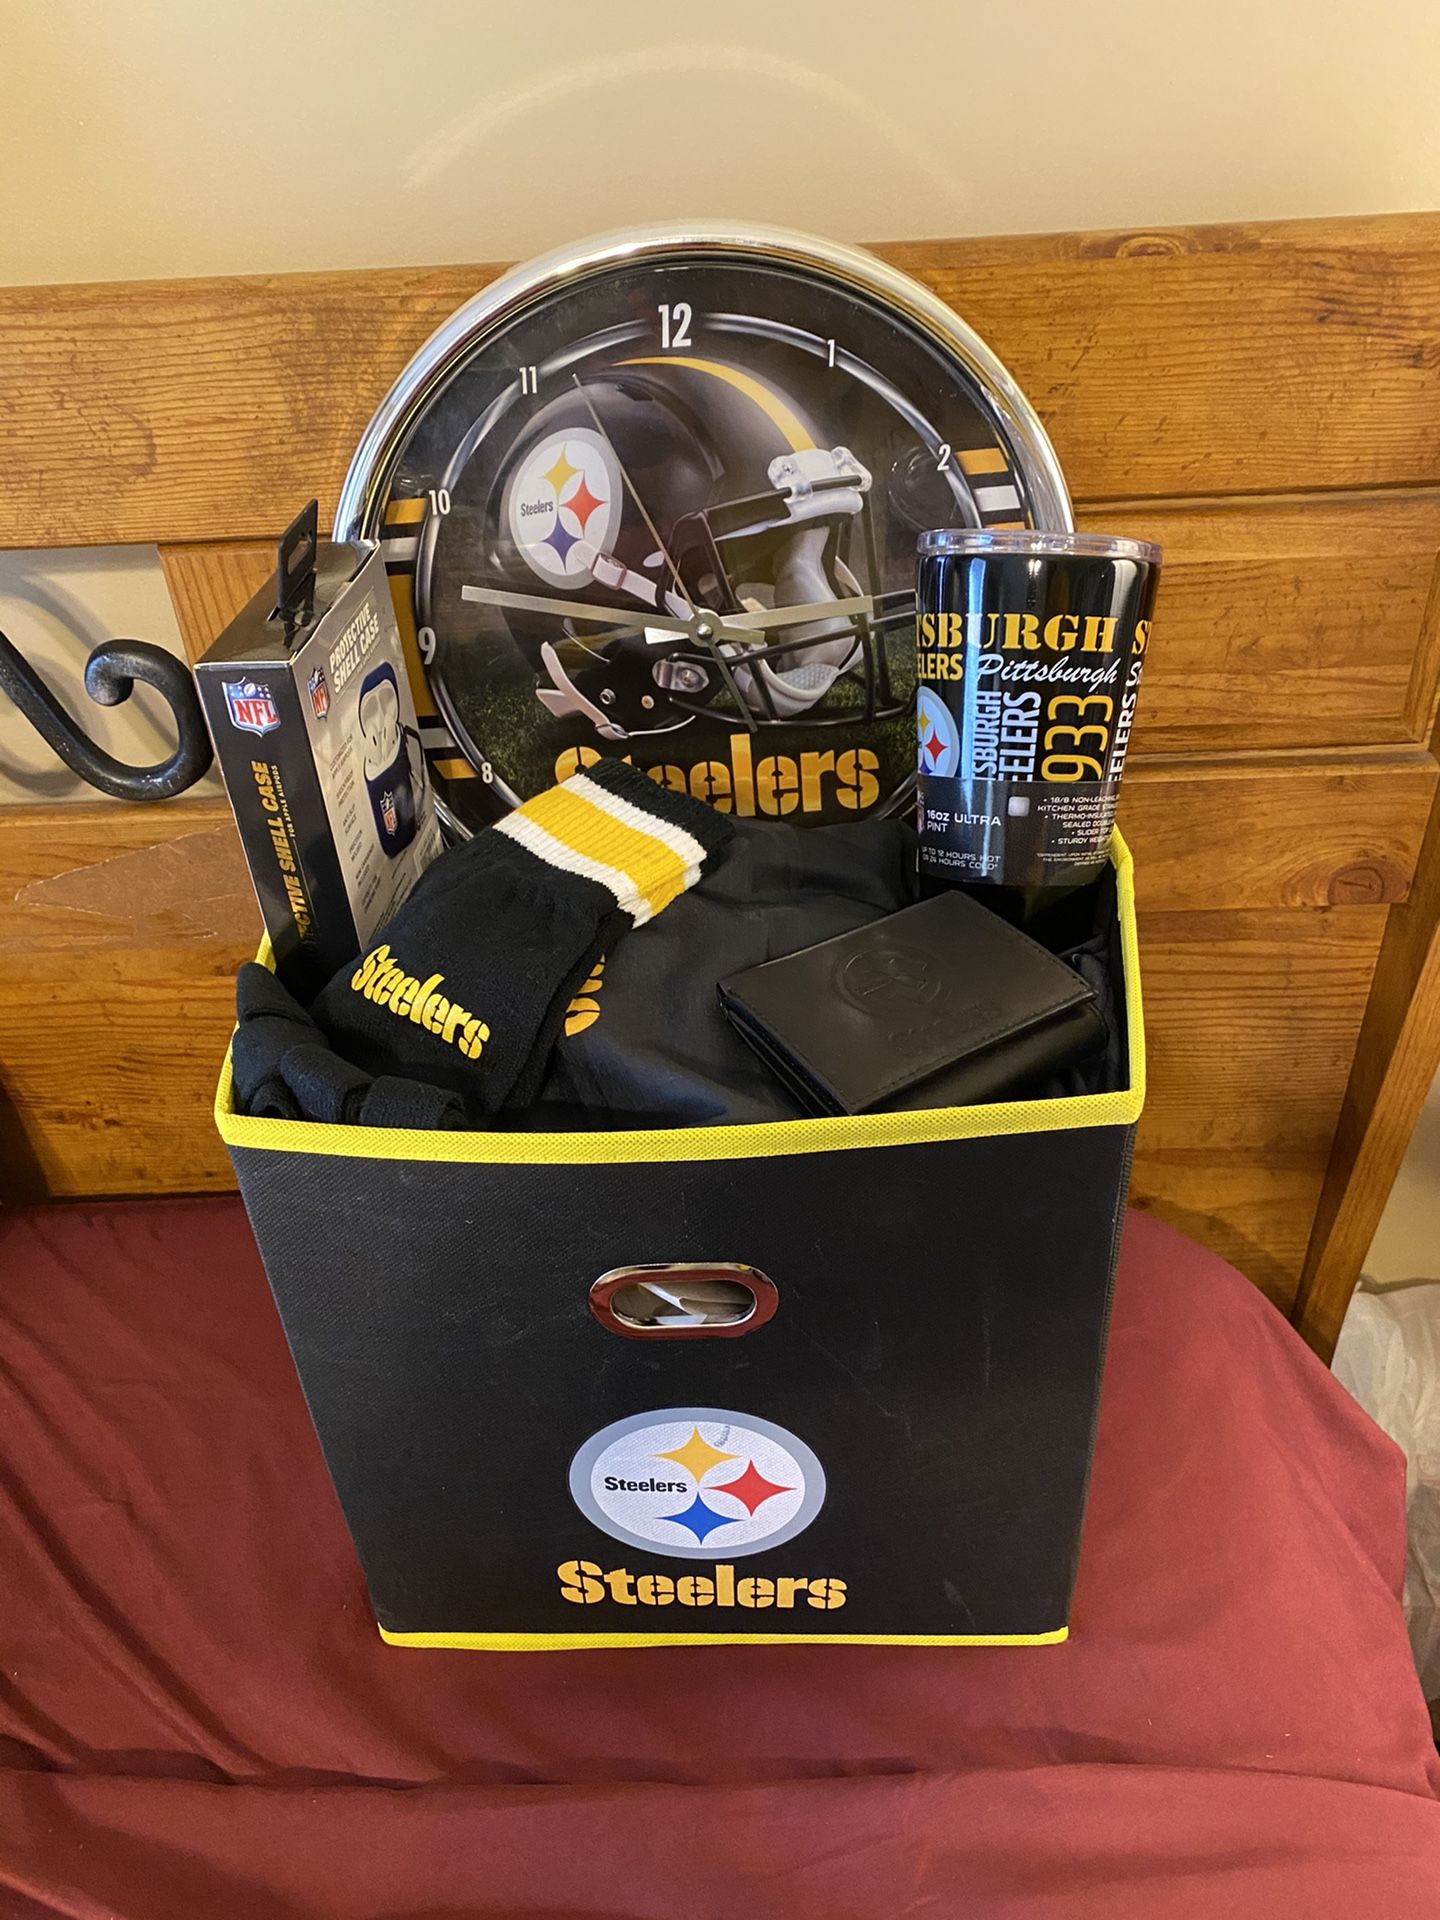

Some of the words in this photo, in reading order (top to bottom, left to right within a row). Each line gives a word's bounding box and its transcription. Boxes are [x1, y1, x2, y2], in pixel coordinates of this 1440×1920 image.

[658, 303, 692, 348] 12
[827, 339, 835, 367] 1
[519, 366, 538, 394] 11
[937, 444, 951, 471] 2
[429, 489, 450, 515] 10
[520, 499, 554, 517] Steelers
[329, 603, 371, 675] PROTECTIVE
[360, 612, 380, 655] CASE
[418, 626, 437, 665] 9
[916, 613, 1118, 652] SBURGH
[333, 645, 361, 694] SHELL
[976, 653, 1121, 693] Pittsburgh
[233, 699, 278, 727] NFL
[251, 760, 280, 813] CASE
[481, 762, 493, 784] 8
[555, 733, 880, 817] Selers
[954, 812, 1002, 827] ULTRA
[1037, 804, 1075, 812] KITCHEN
[926, 821, 948, 833] PINT
[1062, 820, 1091, 828] SEALED
[267, 816, 297, 873] SHELL
[946, 851, 976, 861] HOURS
[938, 858, 966, 867] HOURS
[351, 944, 490, 1060] Steelers
[604, 1476, 688, 1493] Steelers
[556, 1559, 848, 1610] Steelers
